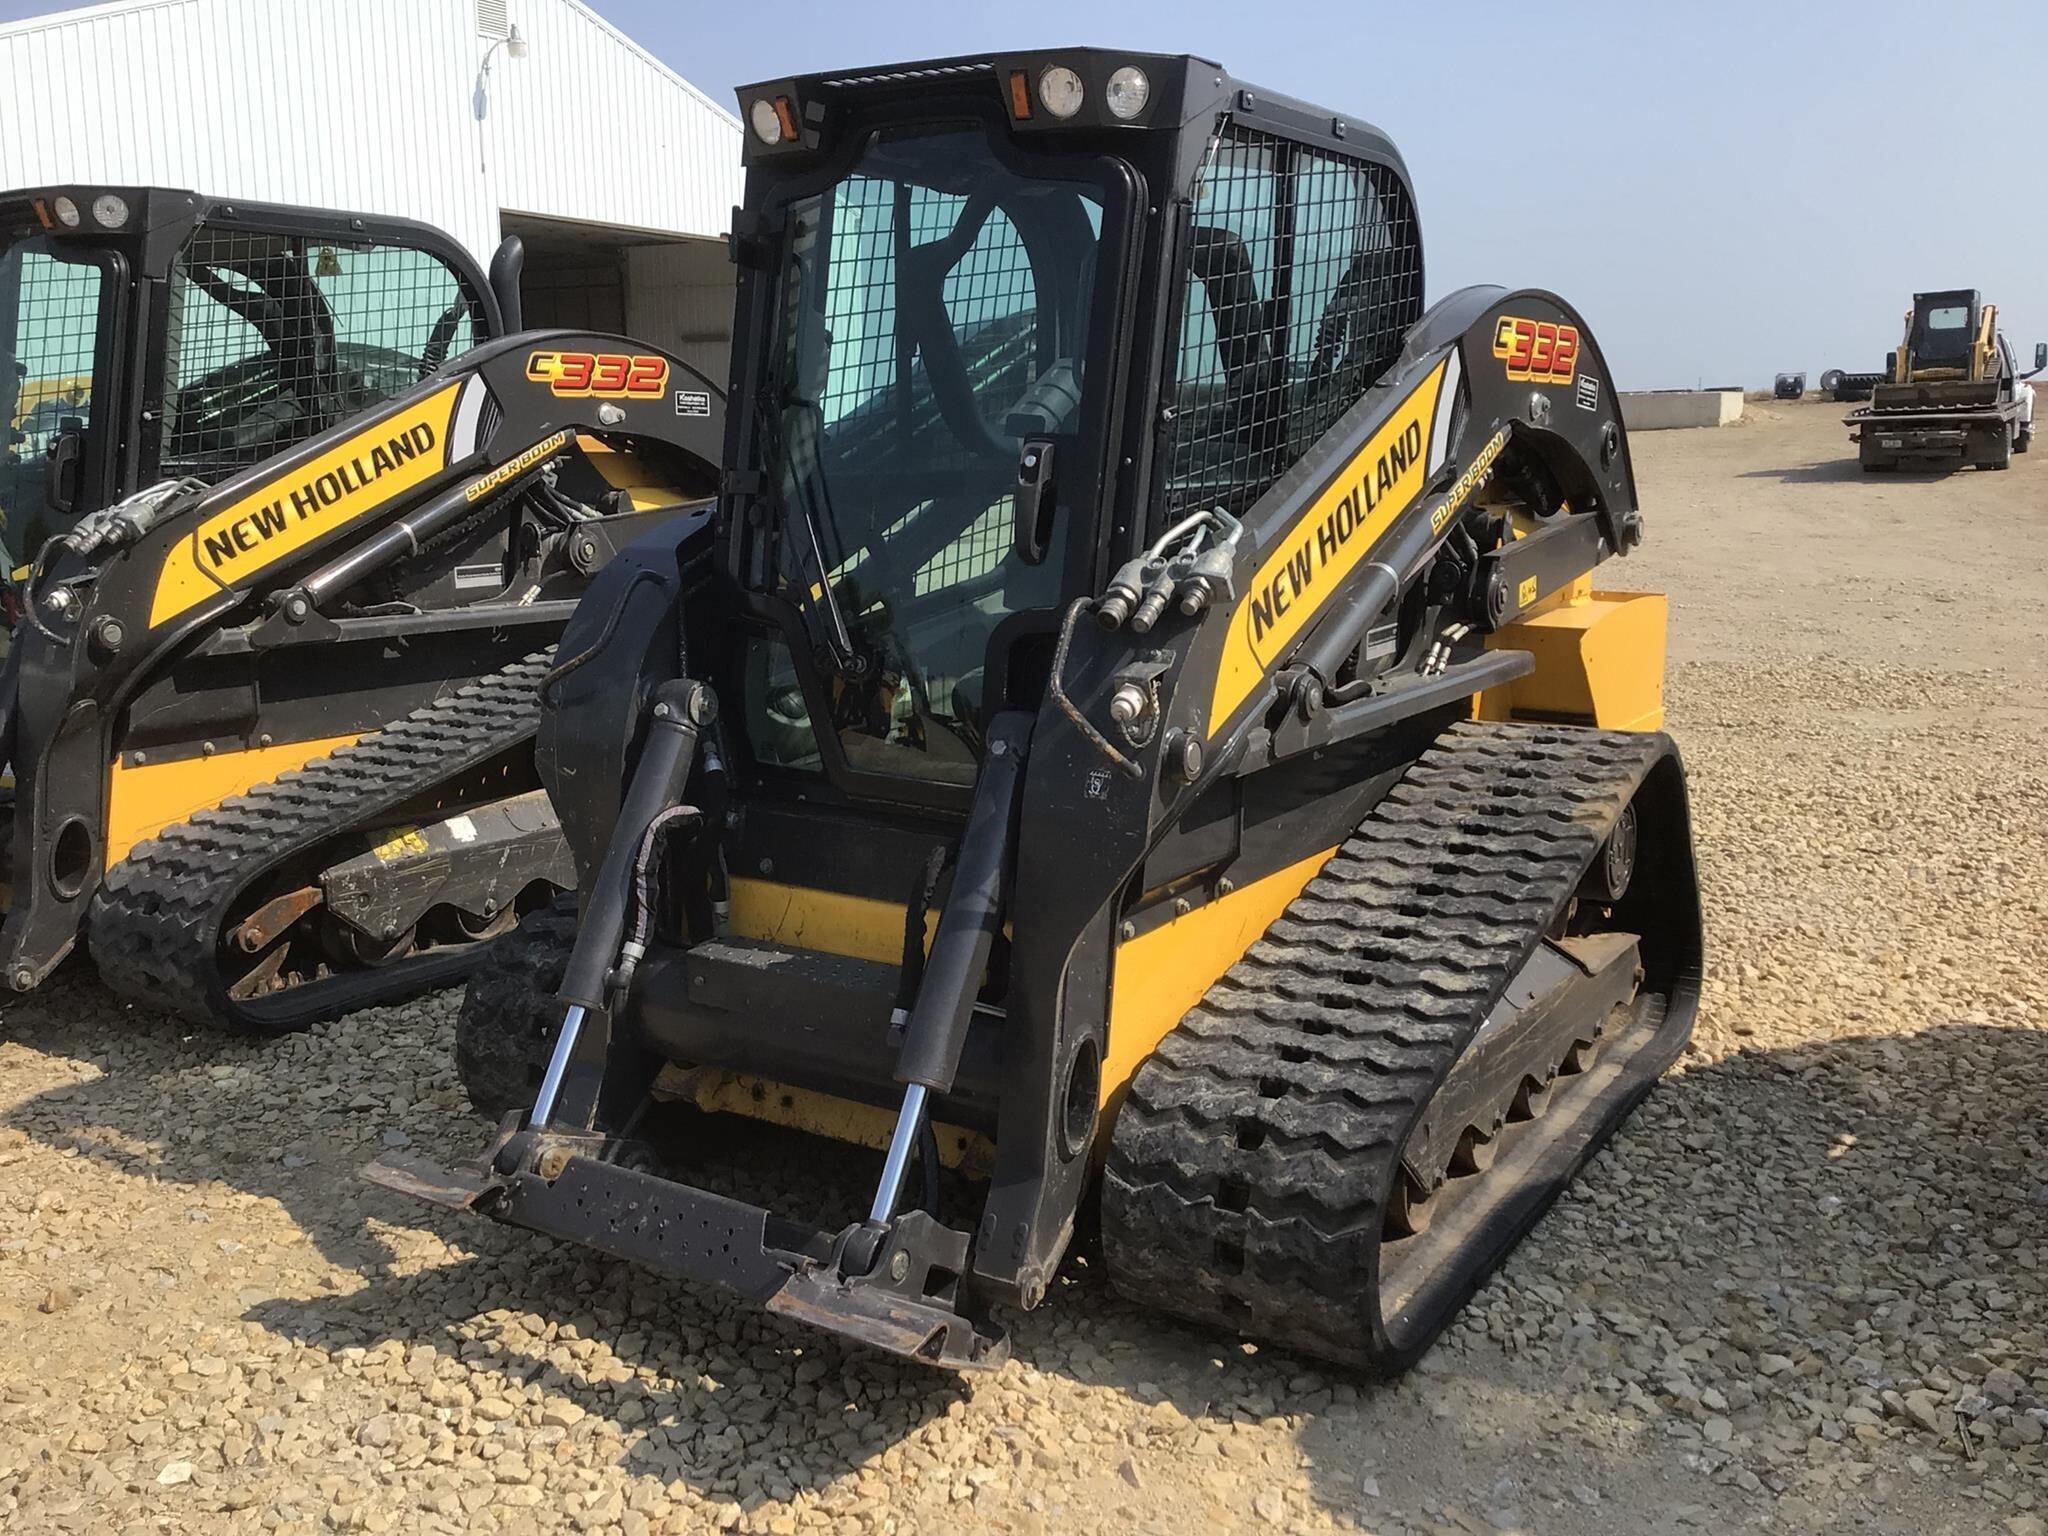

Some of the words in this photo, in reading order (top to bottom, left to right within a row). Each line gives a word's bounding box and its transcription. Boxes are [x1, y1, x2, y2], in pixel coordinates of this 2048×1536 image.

[203, 499, 287, 568] NEW
[289, 422, 436, 520] HOLLAND
[1251, 538, 1312, 644] NEW
[1317, 418, 1421, 568] HOLLAND
